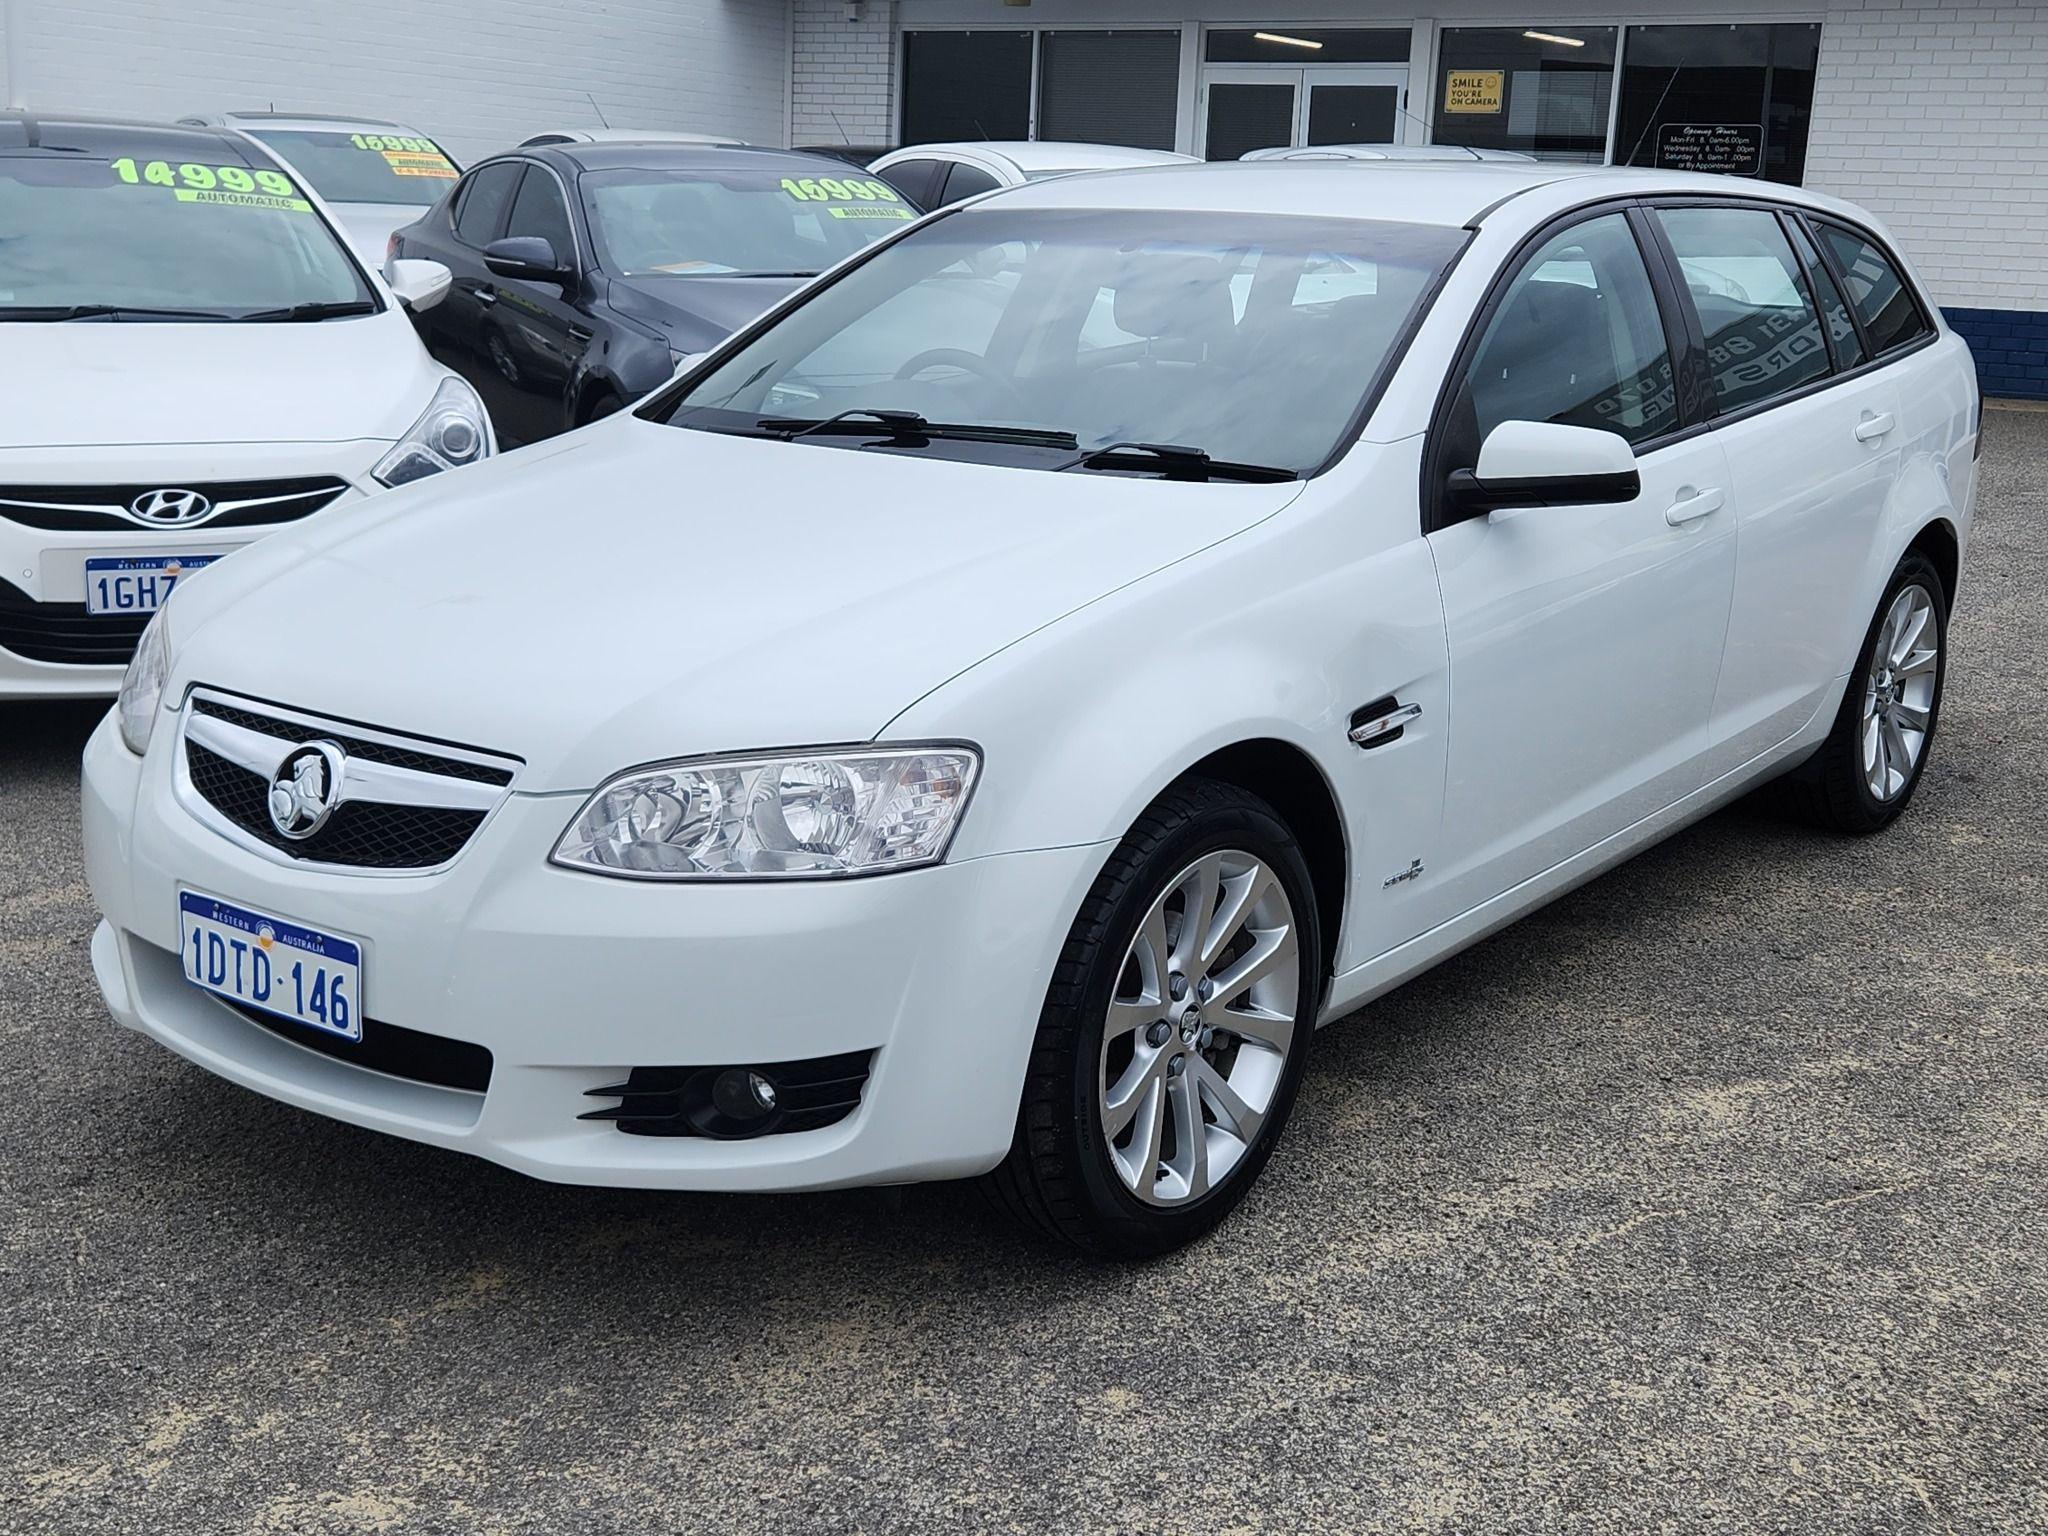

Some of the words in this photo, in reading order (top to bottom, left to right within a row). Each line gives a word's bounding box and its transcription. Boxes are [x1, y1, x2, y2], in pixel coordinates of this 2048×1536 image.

[1452, 79, 1483, 88] SMILE
[1452, 90, 1481, 98] YOU'RE
[1683, 126, 1712, 137] Opening
[1716, 126, 1738, 135] Hours
[1664, 145, 1701, 153] Wednesday
[1665, 152, 1694, 161] Saturday
[1687, 162, 1695, 170] By
[1695, 162, 1736, 170] Appointment
[110, 158, 293, 197] 14999
[781, 178, 898, 202] 15999
[196, 191, 294, 210] AUTOMATIC
[842, 208, 902, 218] AUTOMATIC
[118, 562, 157, 570] WESTERN
[212, 910, 250, 930] WESTERN
[282, 934, 325, 954] AUSTRALIA
